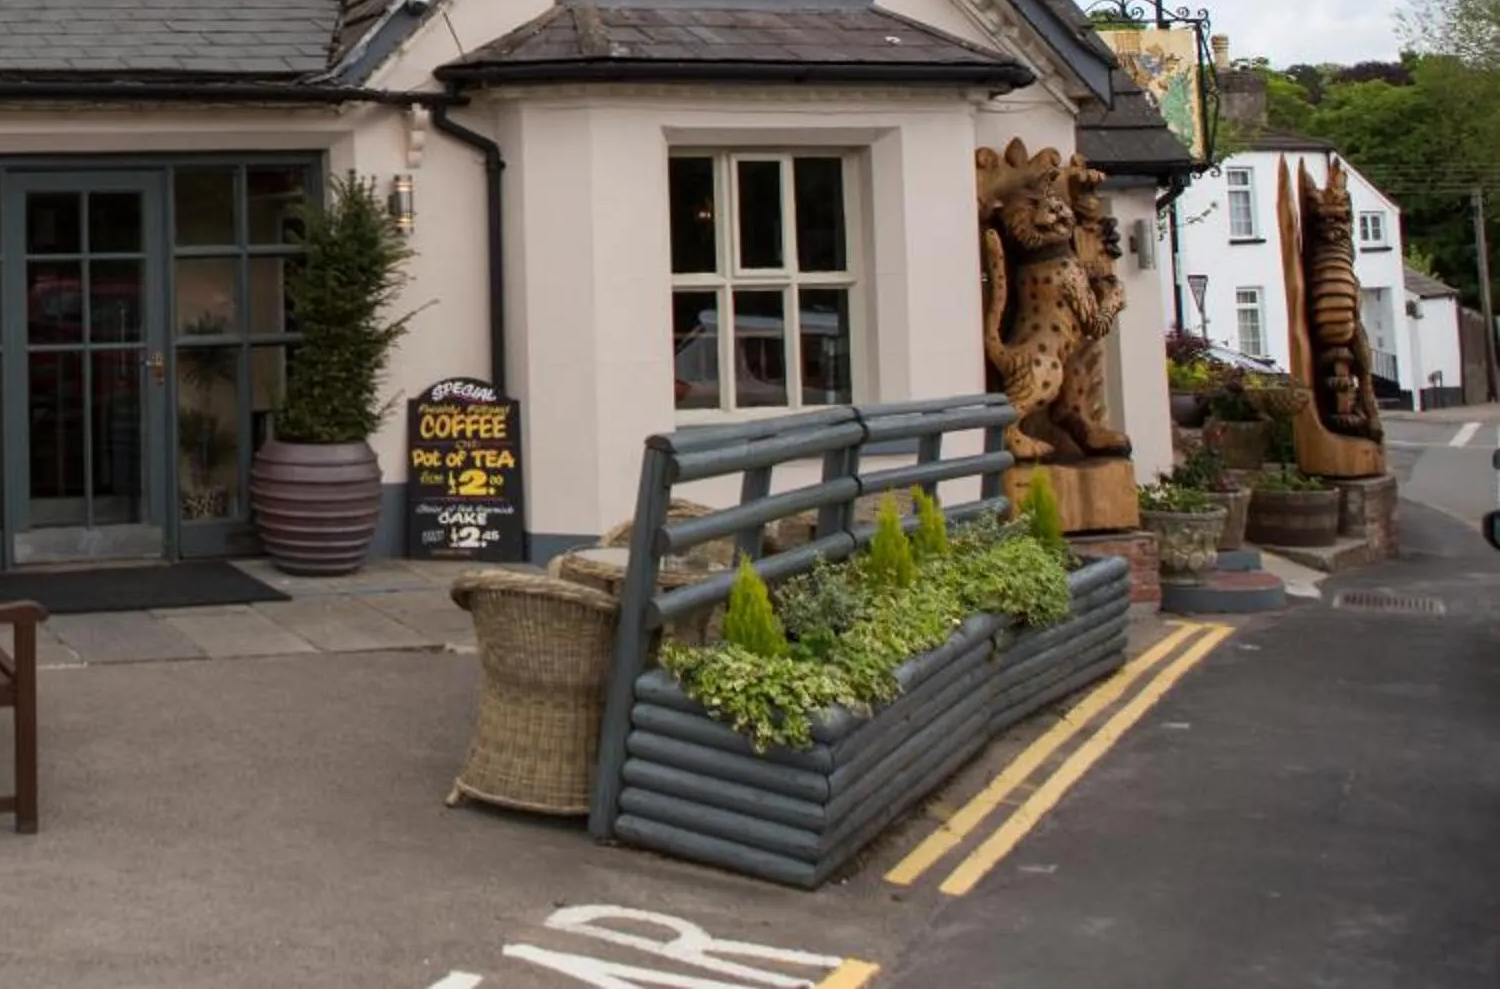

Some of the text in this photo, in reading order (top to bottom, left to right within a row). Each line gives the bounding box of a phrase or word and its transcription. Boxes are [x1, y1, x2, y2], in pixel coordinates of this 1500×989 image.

[420, 414, 507, 439] COFFEE
[412, 449, 442, 467] Pot
[470, 450, 515, 468] TEA
[438, 512, 486, 525] CAKE
